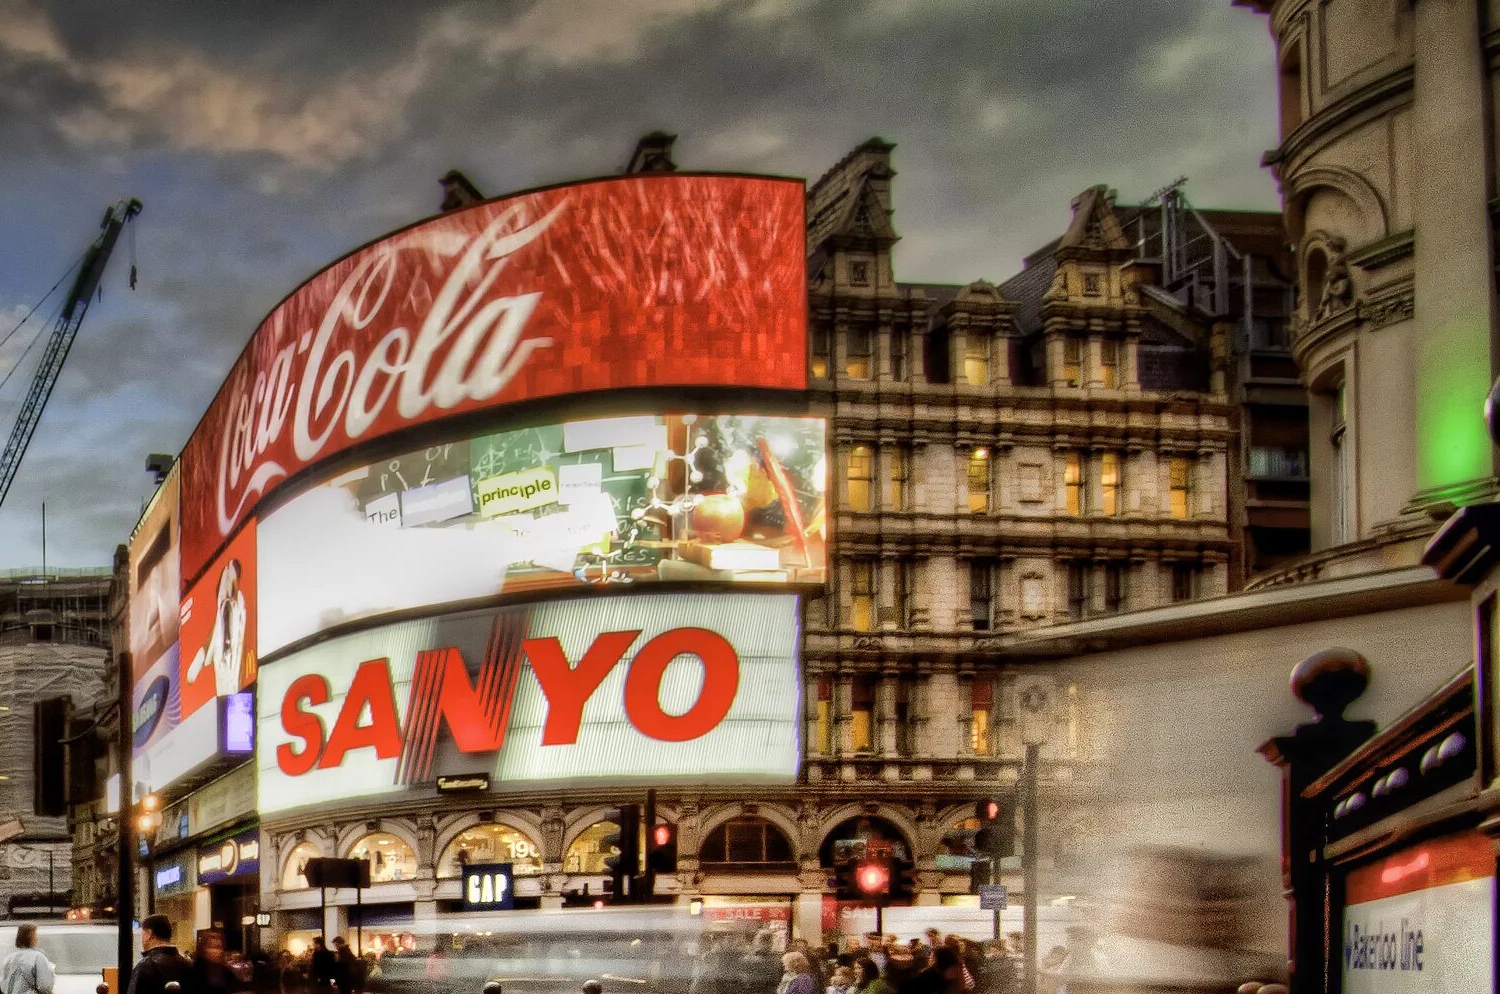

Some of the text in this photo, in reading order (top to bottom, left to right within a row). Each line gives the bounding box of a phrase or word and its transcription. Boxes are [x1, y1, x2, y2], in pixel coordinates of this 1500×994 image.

[217, 197, 570, 536] Coca-Cola
[482, 479, 552, 506] principle
[276, 615, 740, 780] SANYO
[468, 873, 507, 903] GAP
[1401, 918, 1424, 971] line
